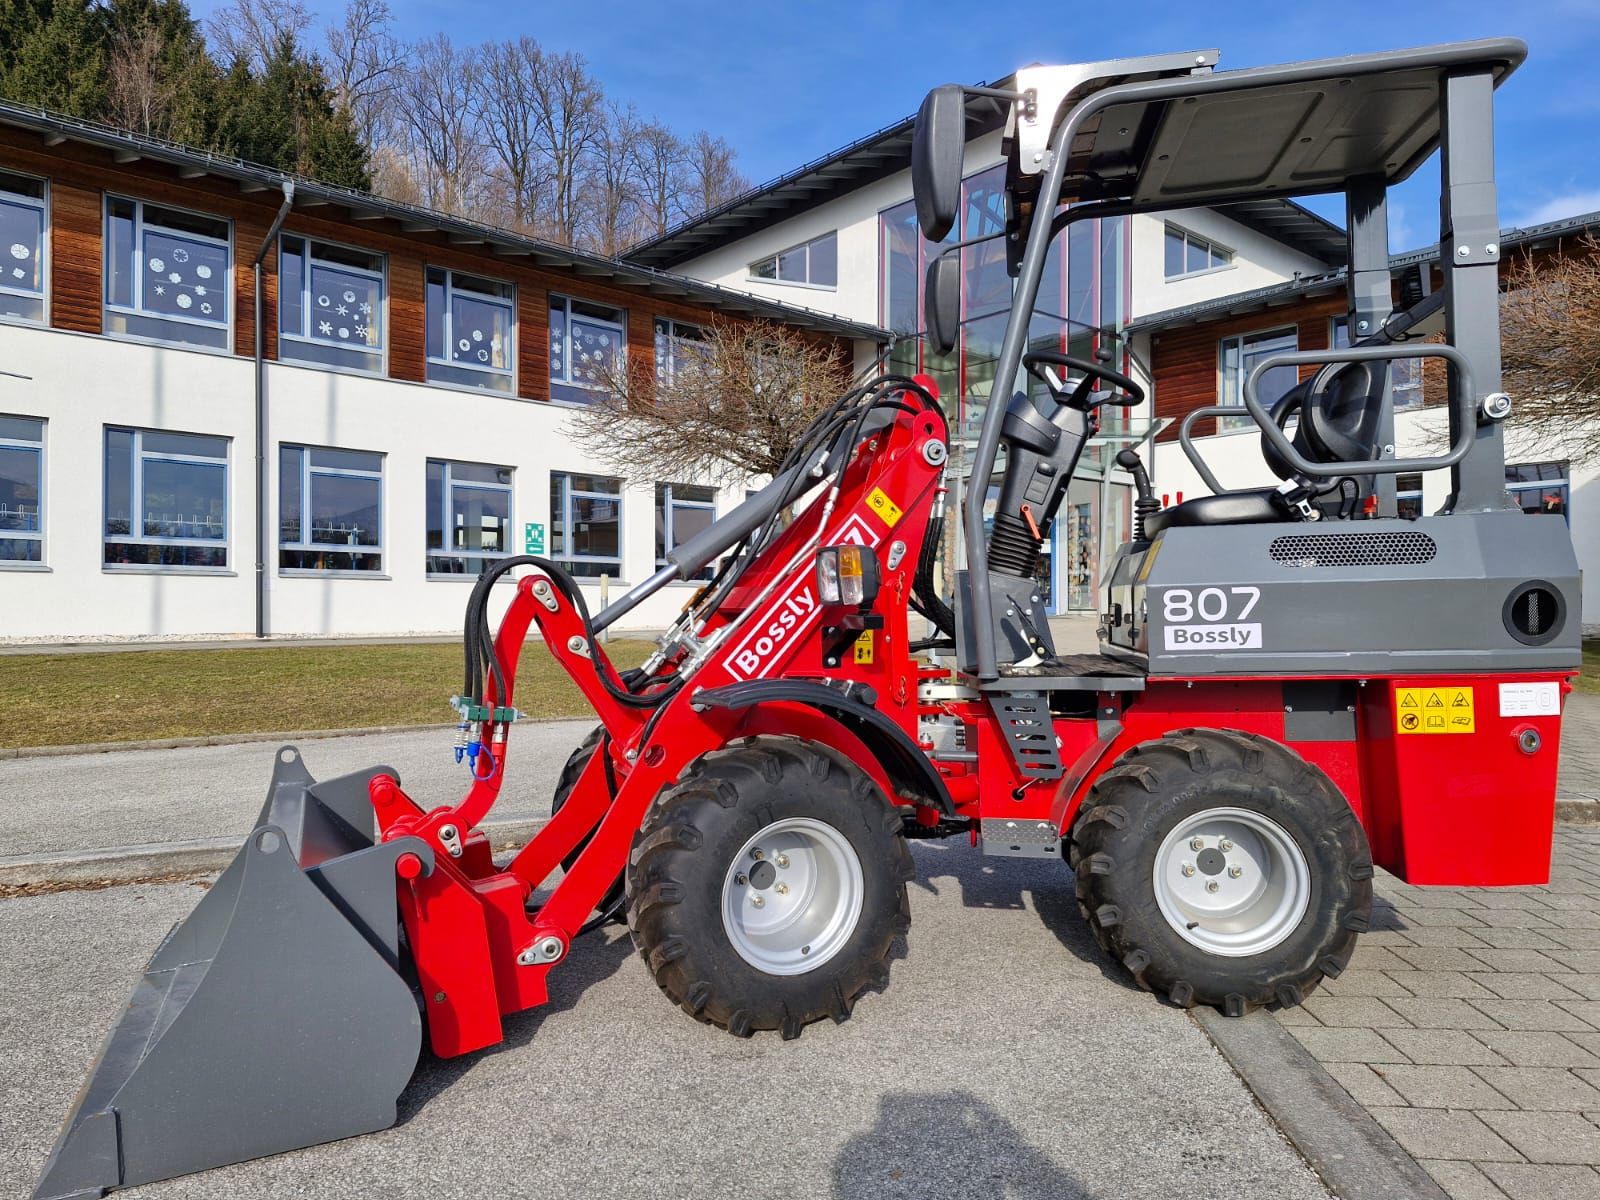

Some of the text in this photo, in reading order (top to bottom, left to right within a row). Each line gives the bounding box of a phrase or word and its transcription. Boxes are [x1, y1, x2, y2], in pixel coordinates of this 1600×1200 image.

[735, 526, 865, 675] Bossly 7
[1163, 586, 1261, 622] 807
[1173, 627, 1251, 646] Bossly
